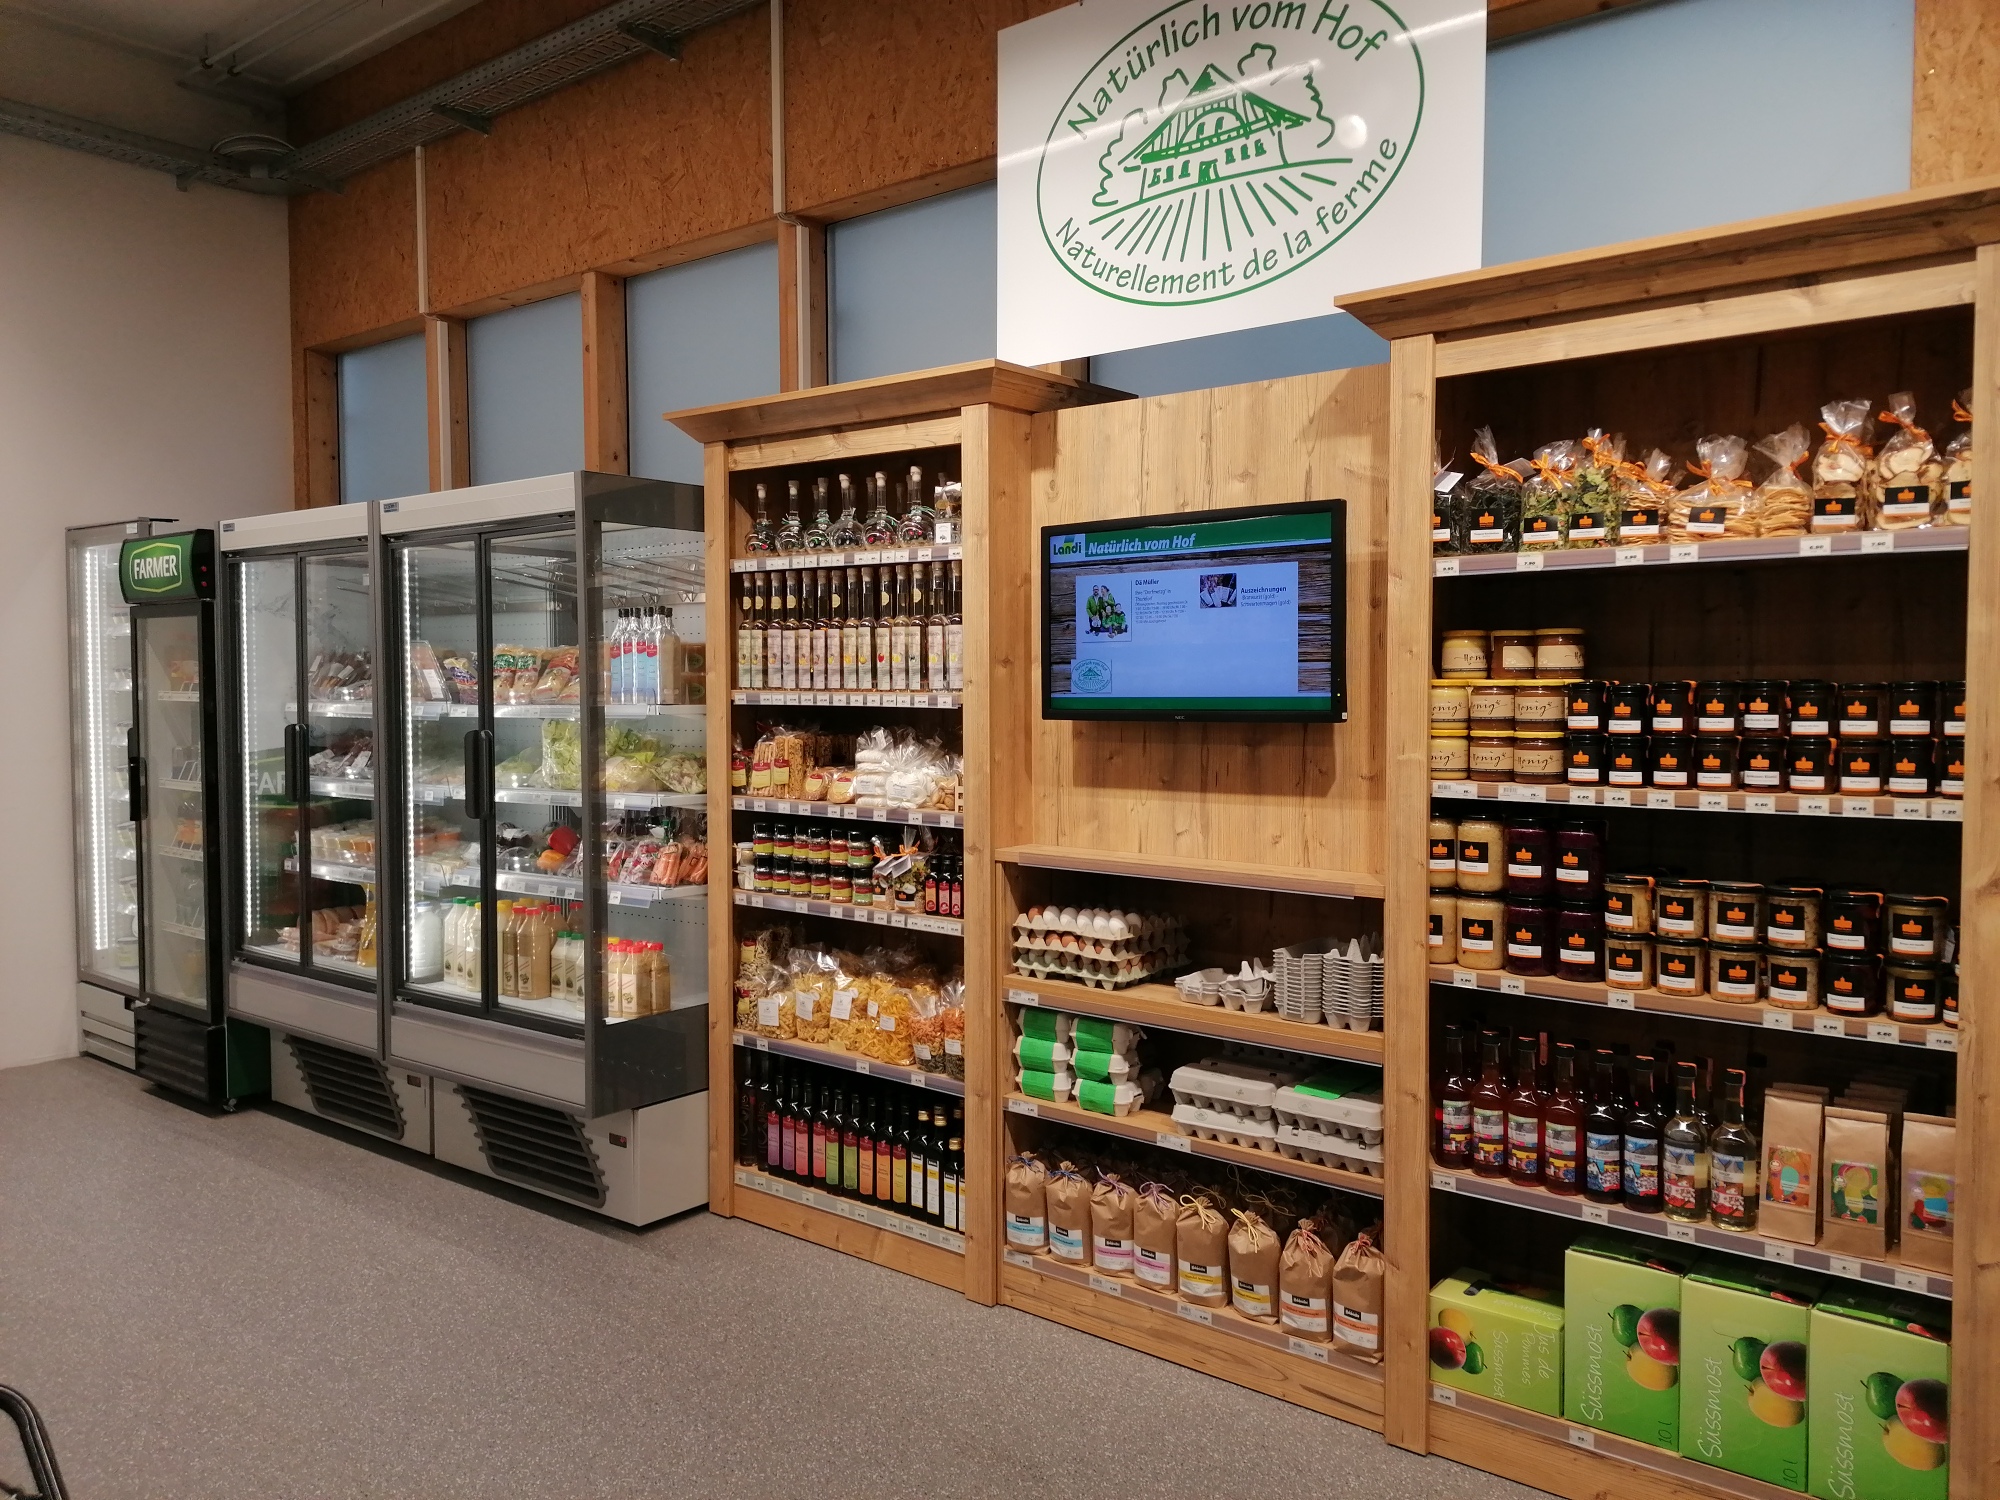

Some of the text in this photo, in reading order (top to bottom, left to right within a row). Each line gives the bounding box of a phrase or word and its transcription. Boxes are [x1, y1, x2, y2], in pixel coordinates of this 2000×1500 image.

[1067, 0, 1388, 140] Natürlich vom Hof
[1055, 136, 1398, 295] Naturellement de la ferme
[1053, 542, 1082, 556] Landi
[1088, 533, 1197, 555] Natürlich vom Hof
[134, 554, 178, 580] FARMER
[1432, 701, 1466, 717] onig
[1431, 750, 1460, 767] nig
[1492, 1330, 1509, 1399] Süssmost
[1533, 1322, 1556, 1379] Jus de
[1580, 1323, 1604, 1422] Süssmost
[1697, 1356, 1724, 1459] Süssmost
[1656, 1428, 1674, 1446] 10
[1827, 1391, 1856, 1500] Süssmost
[1782, 1467, 1798, 1485] 10
